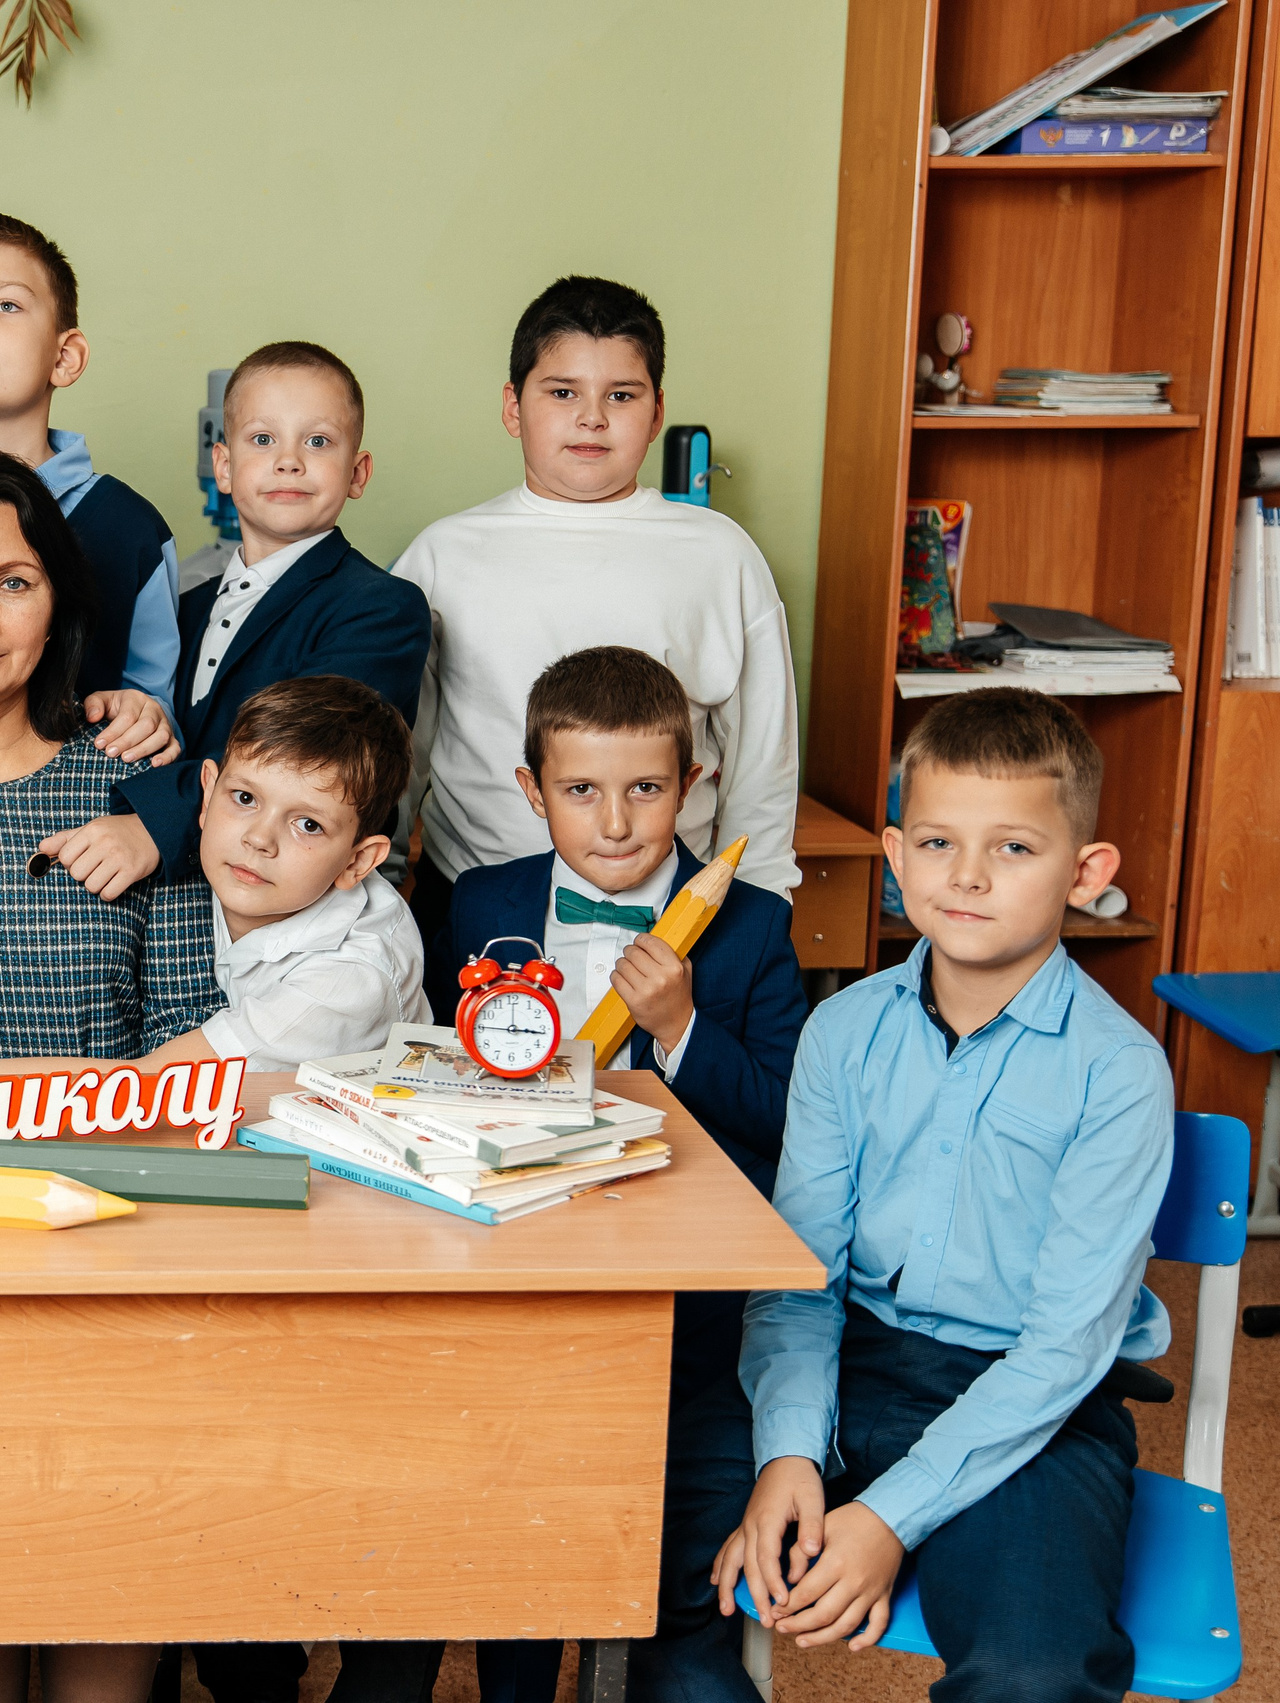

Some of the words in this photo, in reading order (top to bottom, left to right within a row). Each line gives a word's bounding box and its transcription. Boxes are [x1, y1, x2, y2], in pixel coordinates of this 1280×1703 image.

[493, 999, 503, 1009] 11
[506, 994, 520, 1006] 12
[526, 1000, 532, 1010] 1
[482, 1010, 495, 1020] 10
[534, 1008, 542, 1019] 2
[477, 1024, 485, 1034] 9
[539, 1025, 547, 1035] 3
[483, 1039, 490, 1049] 8
[533, 1039, 541, 1049] 4
[494, 1050, 501, 1060] 7
[508, 1052, 515, 1062] 6
[525, 1049, 532, 1059] 5
[391, 1075, 430, 1084] МИР
[434, 1079, 575, 1095] ОКРУЖАЮЩИЙ
[339, 1087, 349, 1099] ОТ
[349, 1091, 371, 1108] ЗЕМЛИ
[321, 1162, 363, 1183] ПИСЬМО
[364, 1176, 372, 1186] И
[373, 1178, 412, 1199] ЧТЕНИЕ
